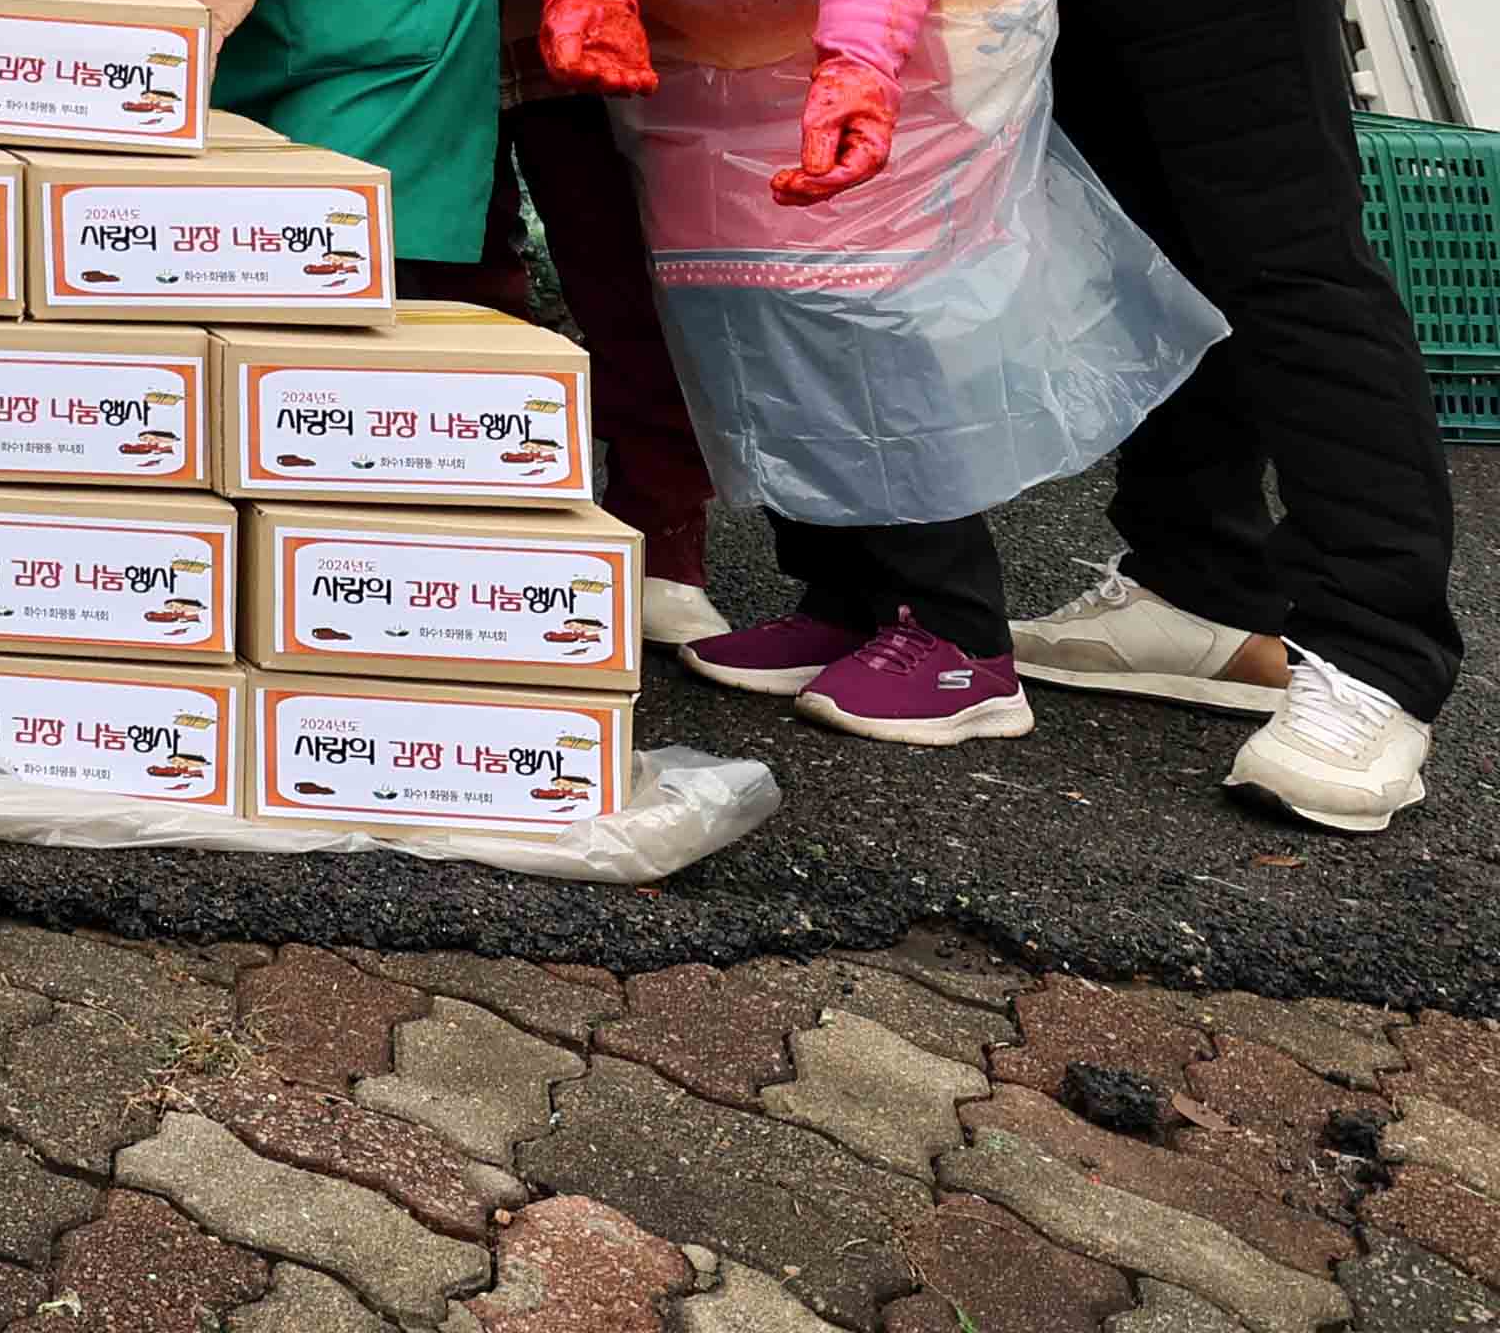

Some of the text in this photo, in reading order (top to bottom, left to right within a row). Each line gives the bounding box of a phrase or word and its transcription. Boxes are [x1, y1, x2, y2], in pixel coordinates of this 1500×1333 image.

[80, 224, 158, 253] 사랑의
[169, 225, 222, 254] 김장
[276, 408, 355, 437] 사랑의
[366, 410, 420, 439] 김장
[11, 560, 65, 590] 김장
[317, 558, 377, 574] 2024년도
[312, 575, 393, 607] 사랑의
[405, 580, 461, 610] 김장
[299, 717, 360, 734] 2024년도
[294, 735, 376, 767] 사랑의
[389, 741, 445, 771] 김장
